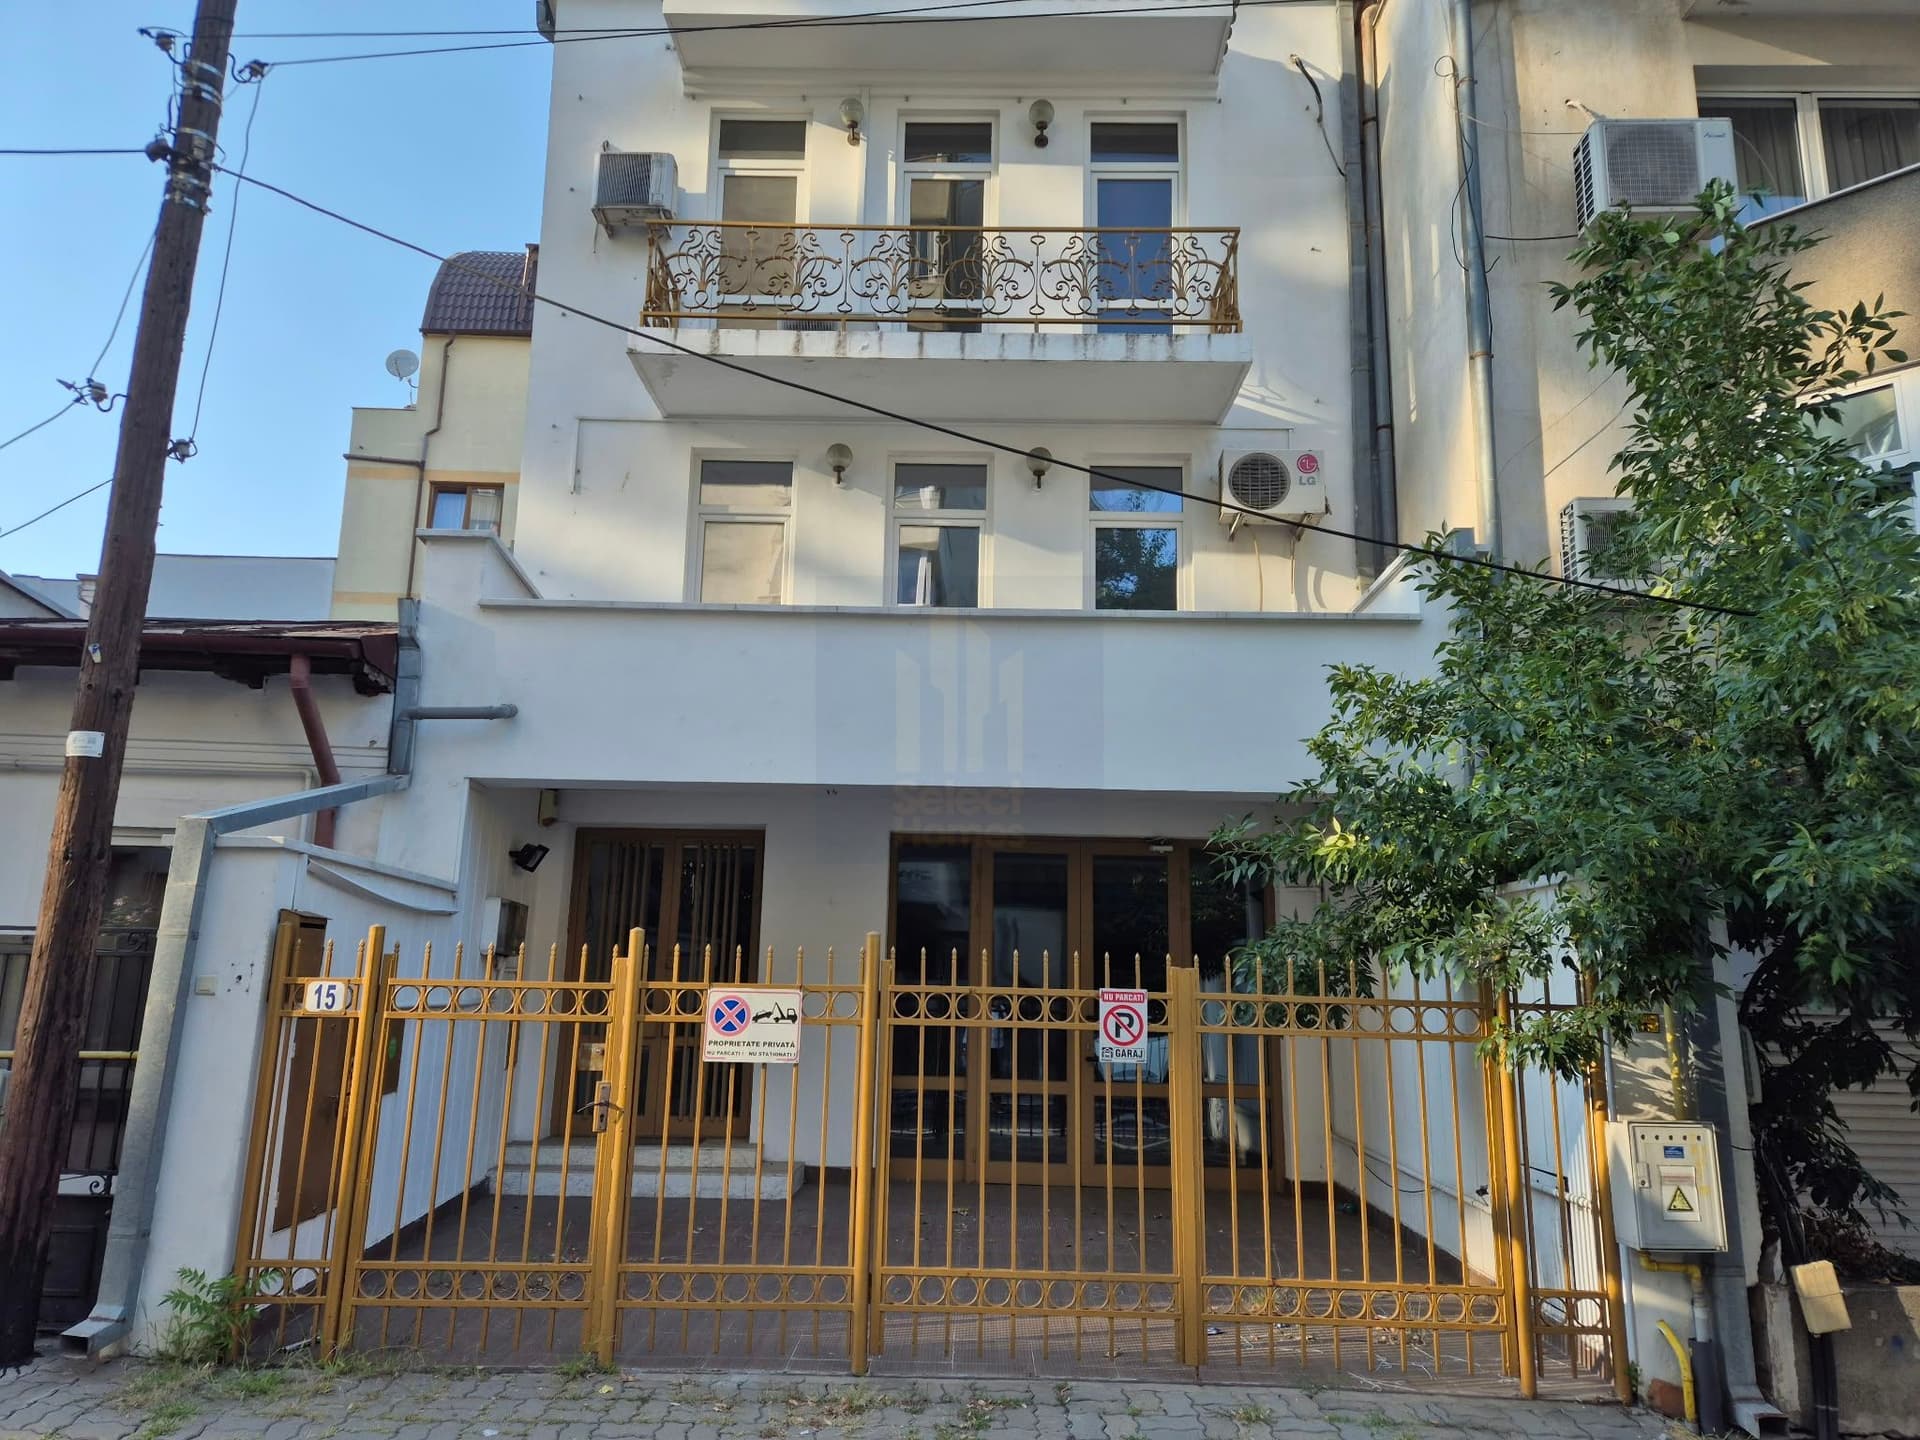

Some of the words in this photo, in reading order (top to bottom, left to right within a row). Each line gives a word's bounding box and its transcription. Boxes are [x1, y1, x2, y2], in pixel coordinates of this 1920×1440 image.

[1298, 475, 1317, 486] LG
[314, 983, 337, 1010] 15
[1103, 993, 1114, 1001] NU
[1115, 1047, 1143, 1058] GARAJ
